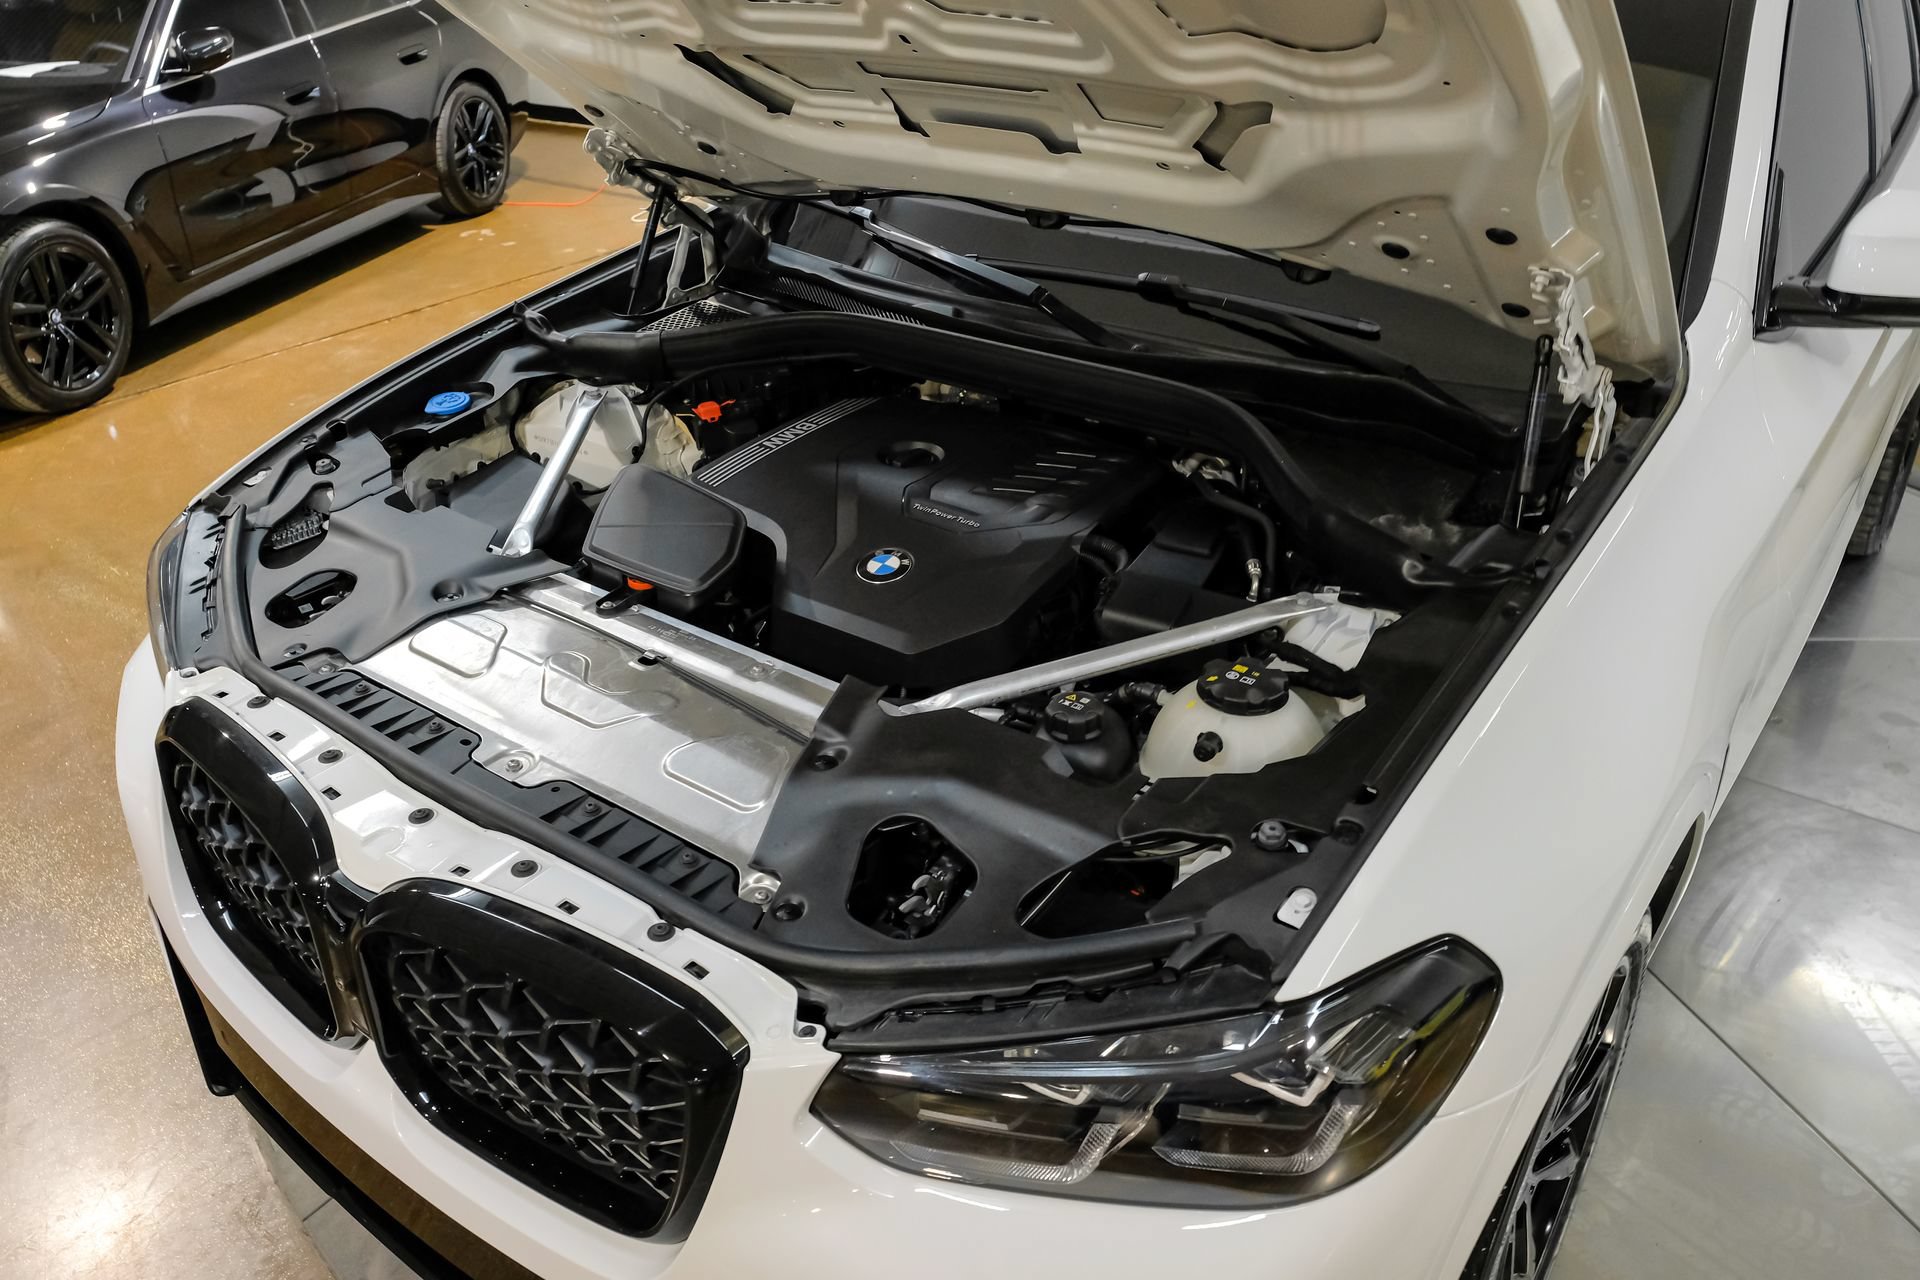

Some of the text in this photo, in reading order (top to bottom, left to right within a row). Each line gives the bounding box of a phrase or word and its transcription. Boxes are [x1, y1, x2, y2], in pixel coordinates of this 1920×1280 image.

[763, 422, 818, 448] BMW
[913, 503, 980, 528] TwinPower Turbo
